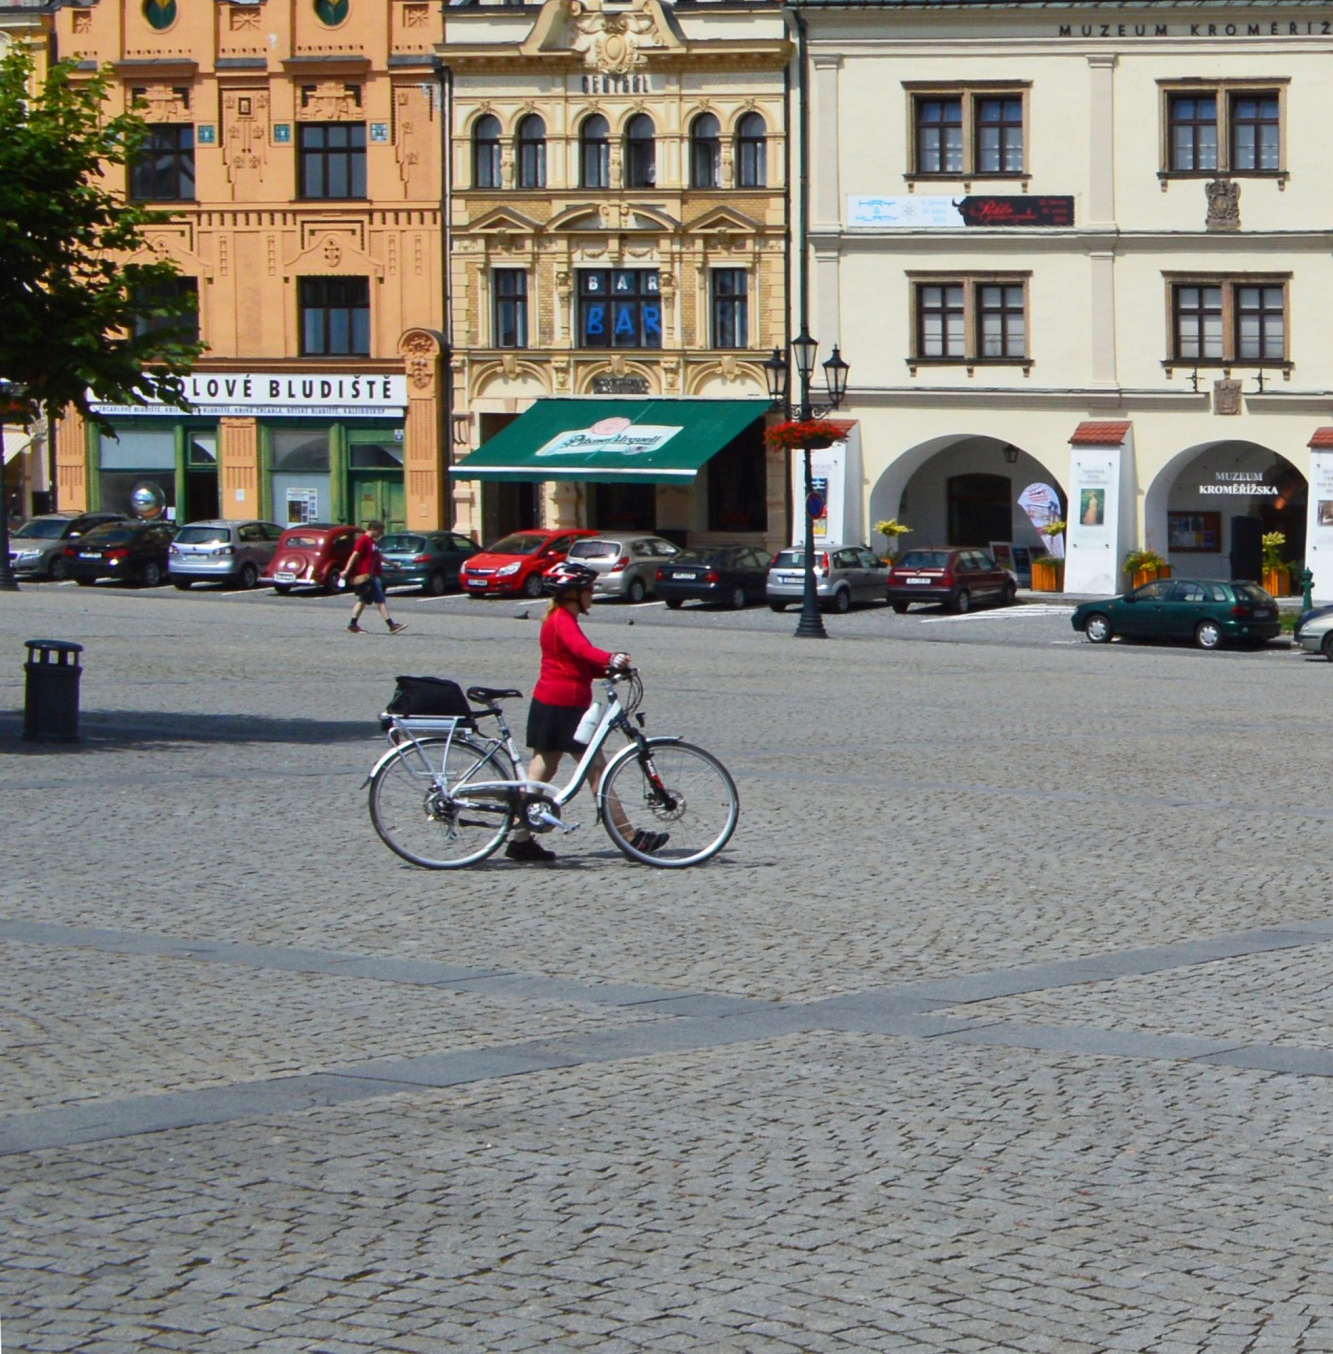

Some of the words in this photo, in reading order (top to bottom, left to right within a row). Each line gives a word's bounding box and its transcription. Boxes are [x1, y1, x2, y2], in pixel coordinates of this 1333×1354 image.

[1059, 24, 1168, 37] MUZEUM
[588, 276, 658, 290] BAR
[586, 306, 662, 335] BAR
[269, 374, 391, 399] BLUDIŠTĚ
[1215, 472, 1263, 481] MUZEUM
